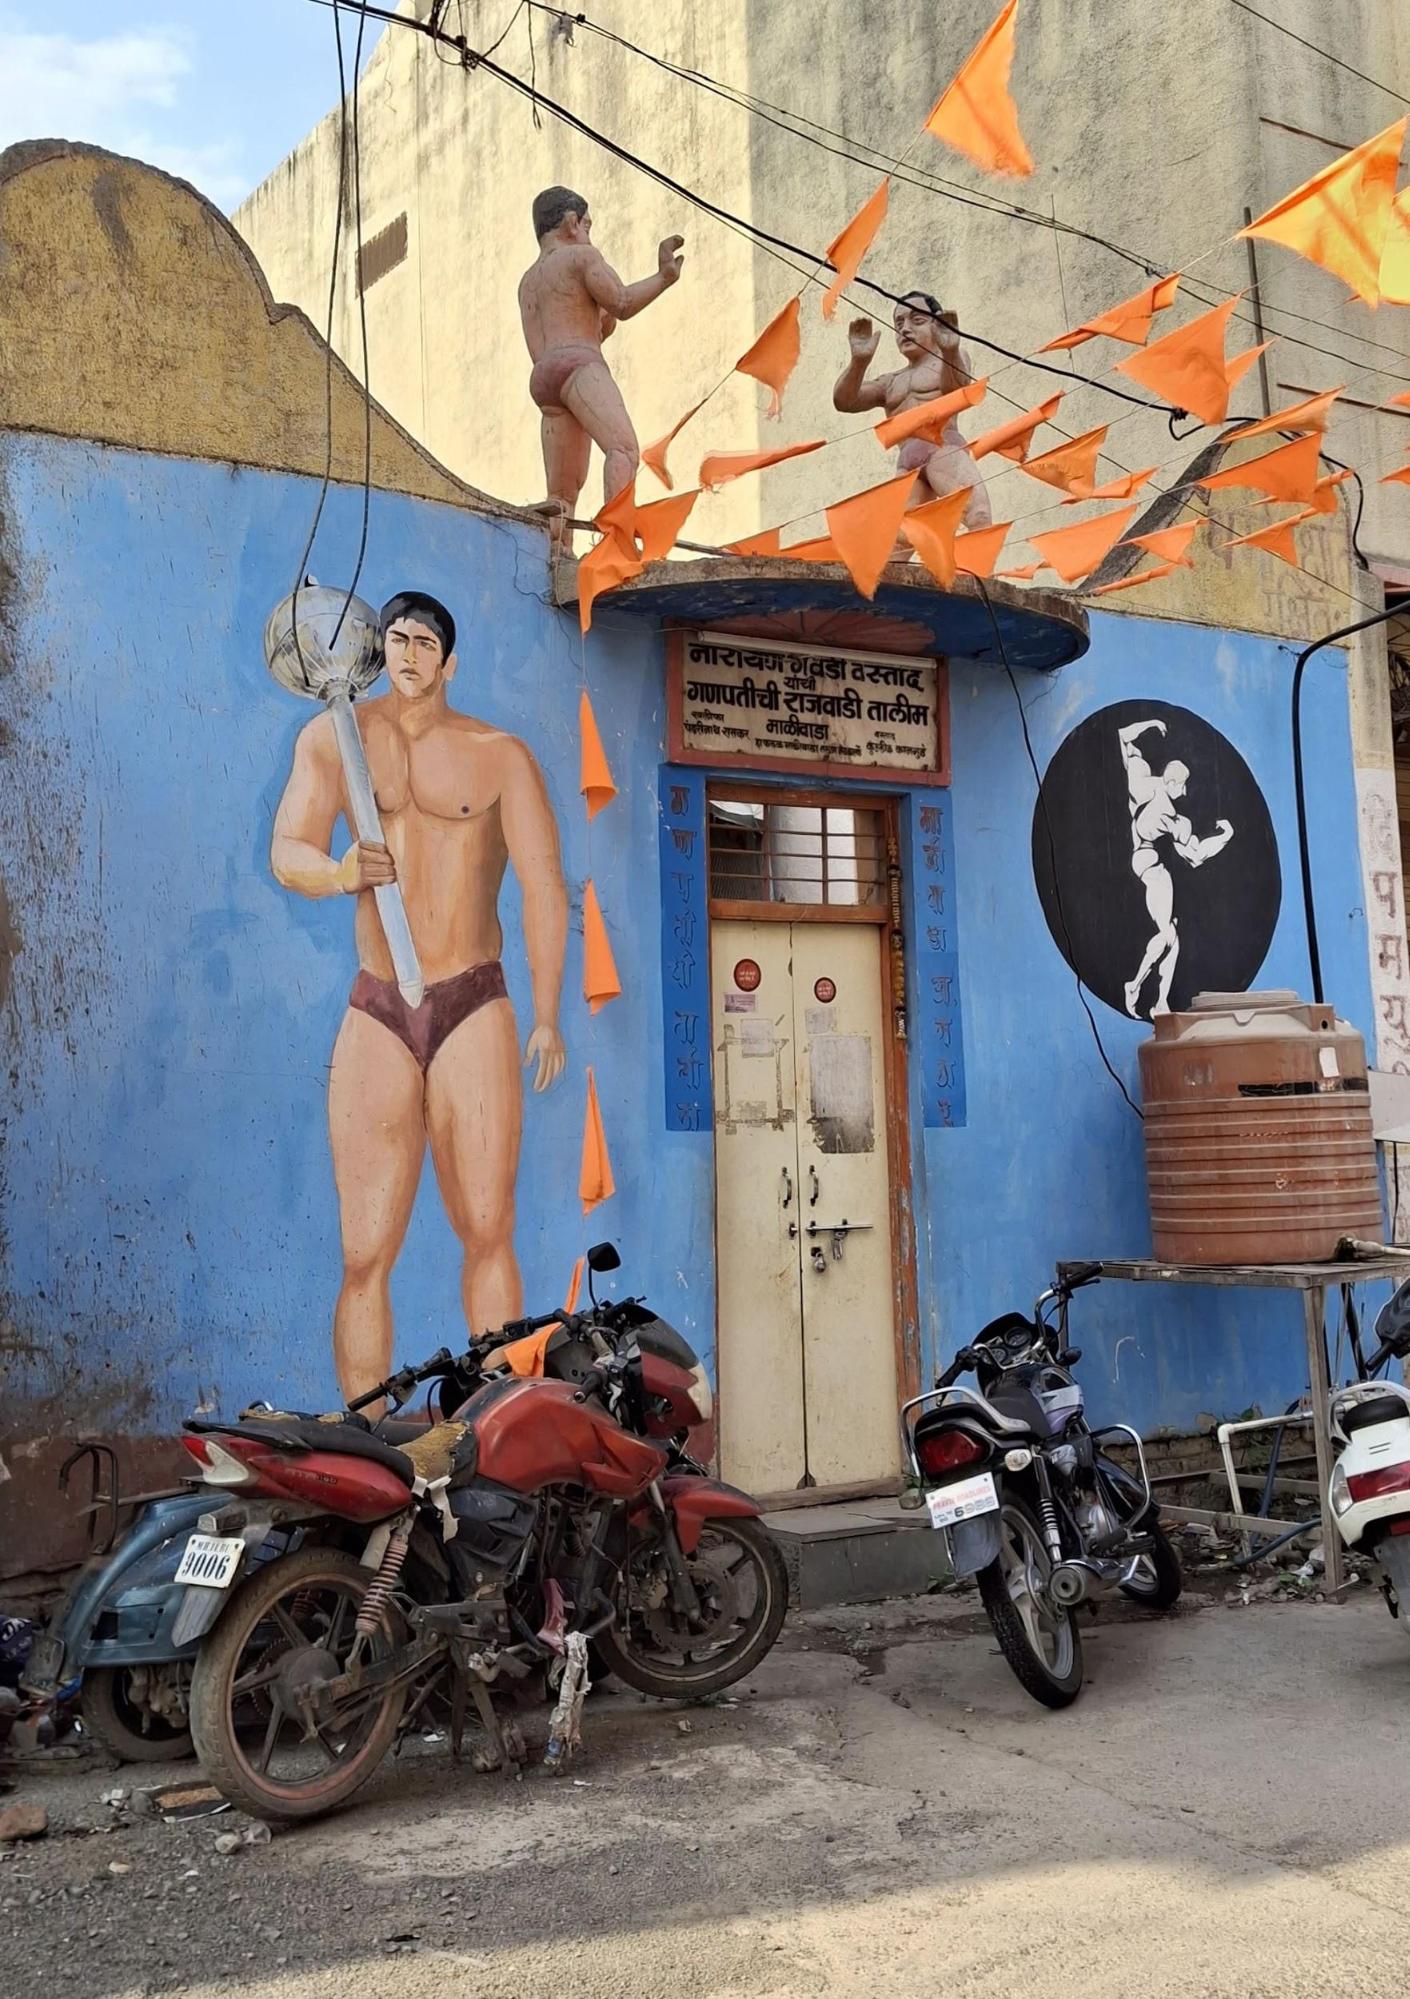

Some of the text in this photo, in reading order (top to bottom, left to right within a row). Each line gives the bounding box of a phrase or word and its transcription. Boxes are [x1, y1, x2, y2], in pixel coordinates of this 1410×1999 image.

[689, 643, 784, 673] नारायण
[851, 662, 925, 692] वस्ताद
[784, 675, 816, 691] यांची
[687, 677, 929, 726] गणपतीची राजवाडी तालीम
[766, 714, 829, 740] माळीवाडा
[182, 1552, 230, 1581] 9006
